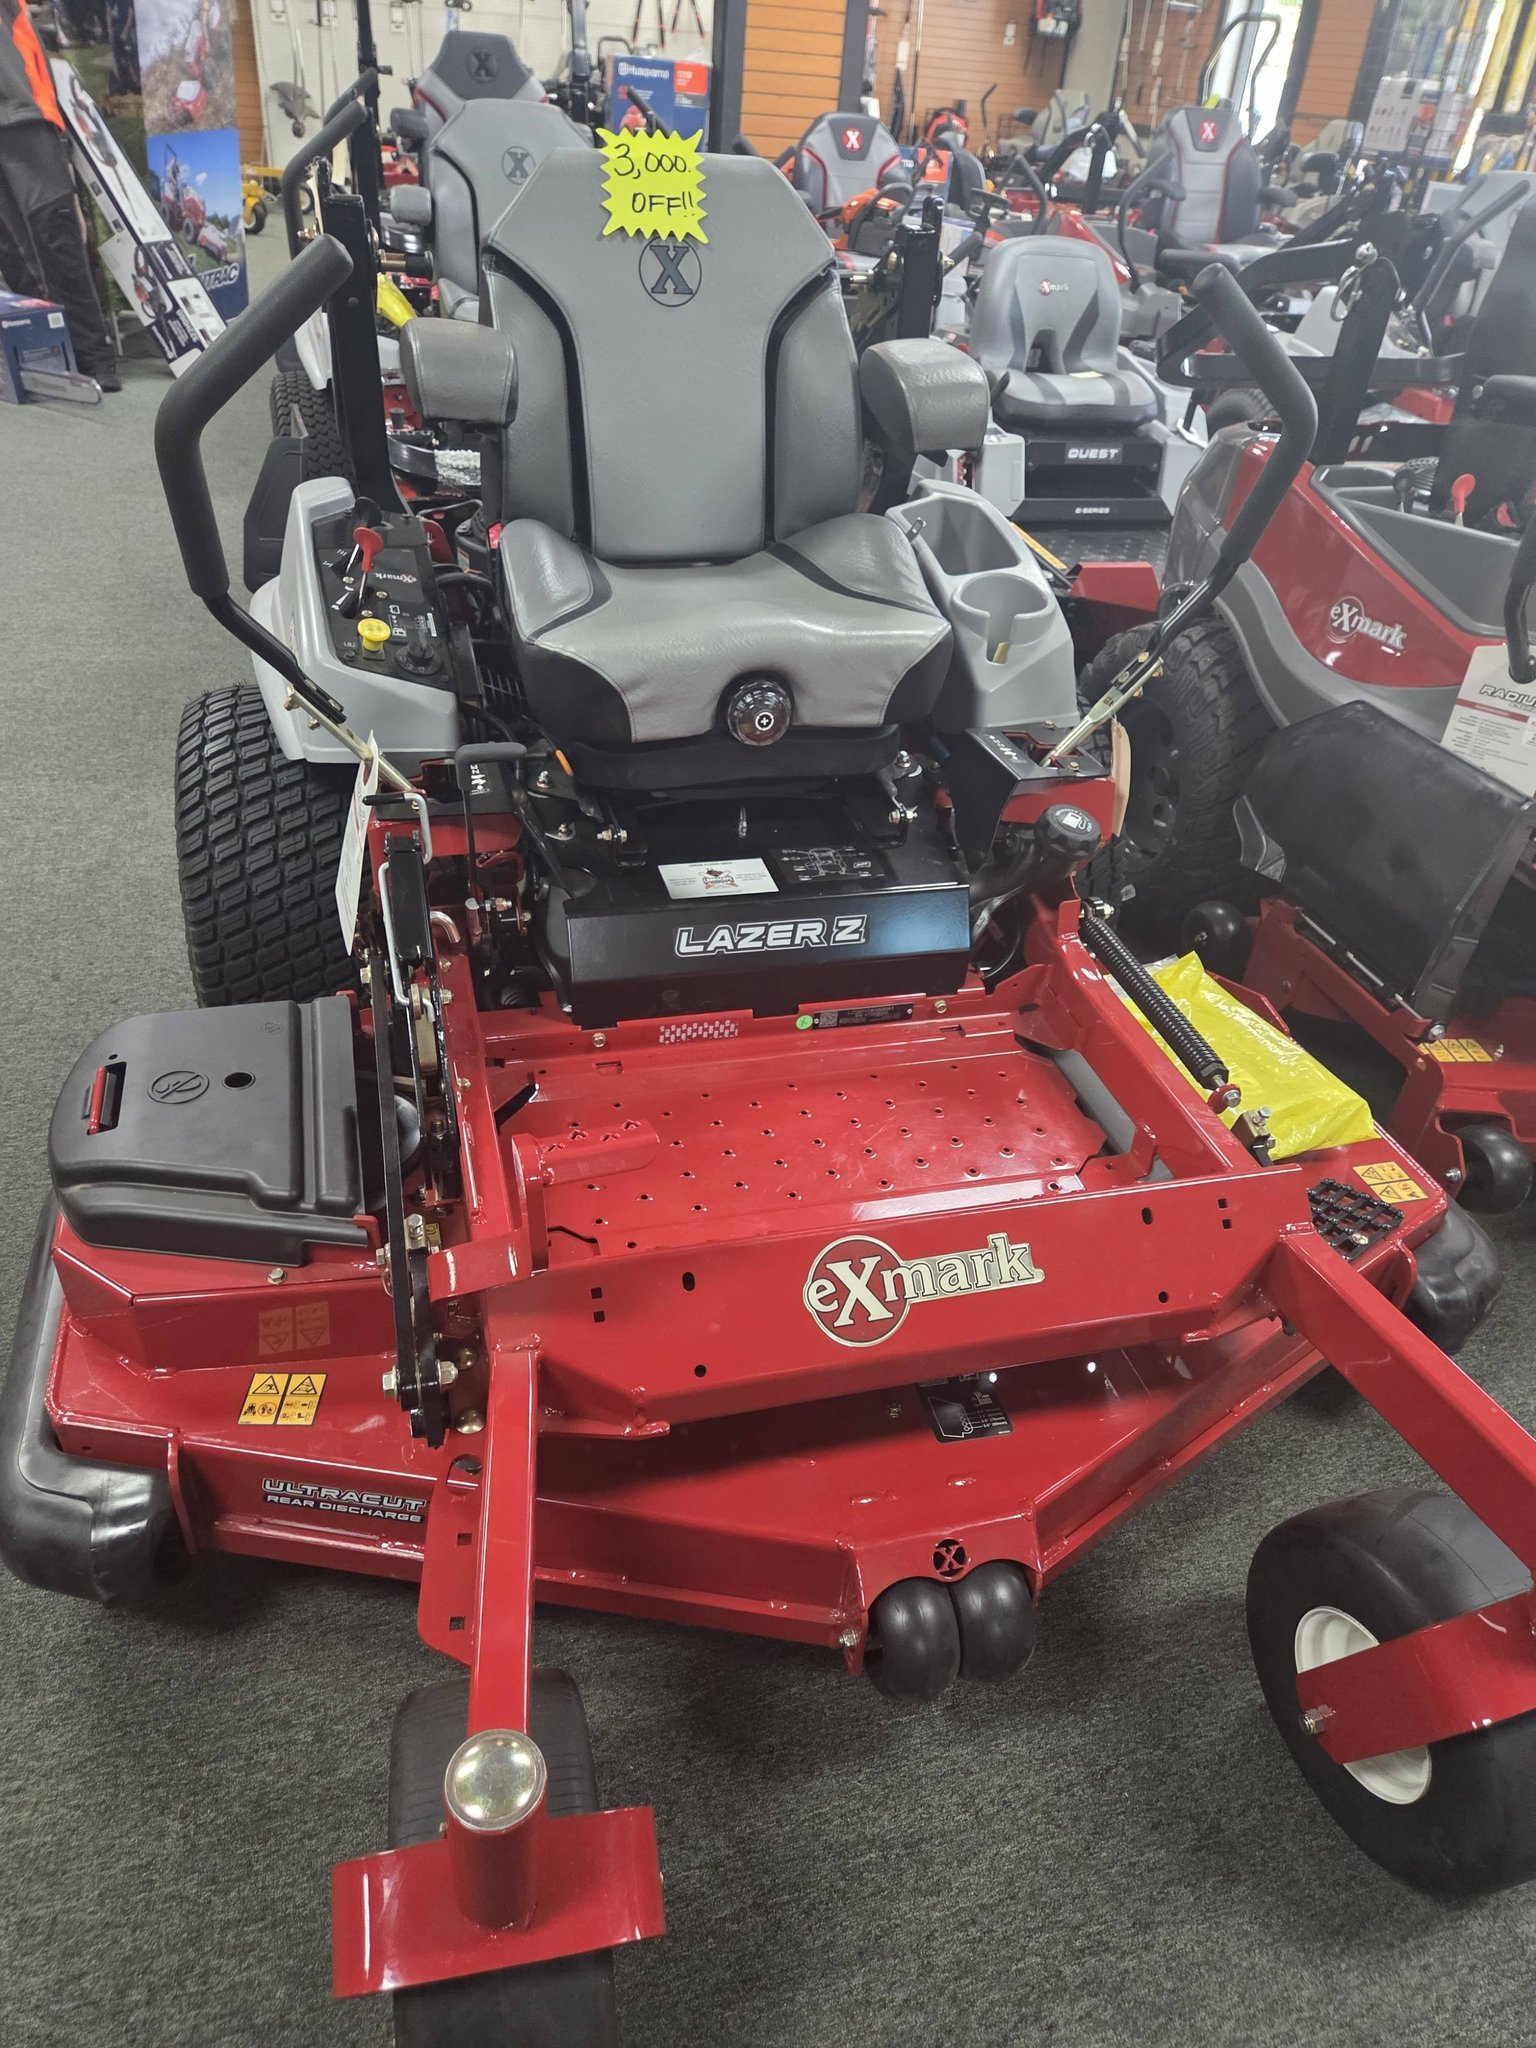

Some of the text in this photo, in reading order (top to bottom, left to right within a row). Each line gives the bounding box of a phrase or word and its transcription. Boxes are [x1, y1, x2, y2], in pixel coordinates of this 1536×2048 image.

[631, 190, 695, 218] OFF!!
[650, 244, 694, 295] X
[1067, 447, 1119, 459] QUEST
[1329, 600, 1408, 649] eXmark
[1479, 683, 1536, 706] RADIU
[676, 915, 867, 957] LAZER Z
[806, 1235, 1038, 1329] eXmark
[262, 1478, 427, 1511] ULTRACUT
[267, 1494, 422, 1522] REAR DISCHARGE
